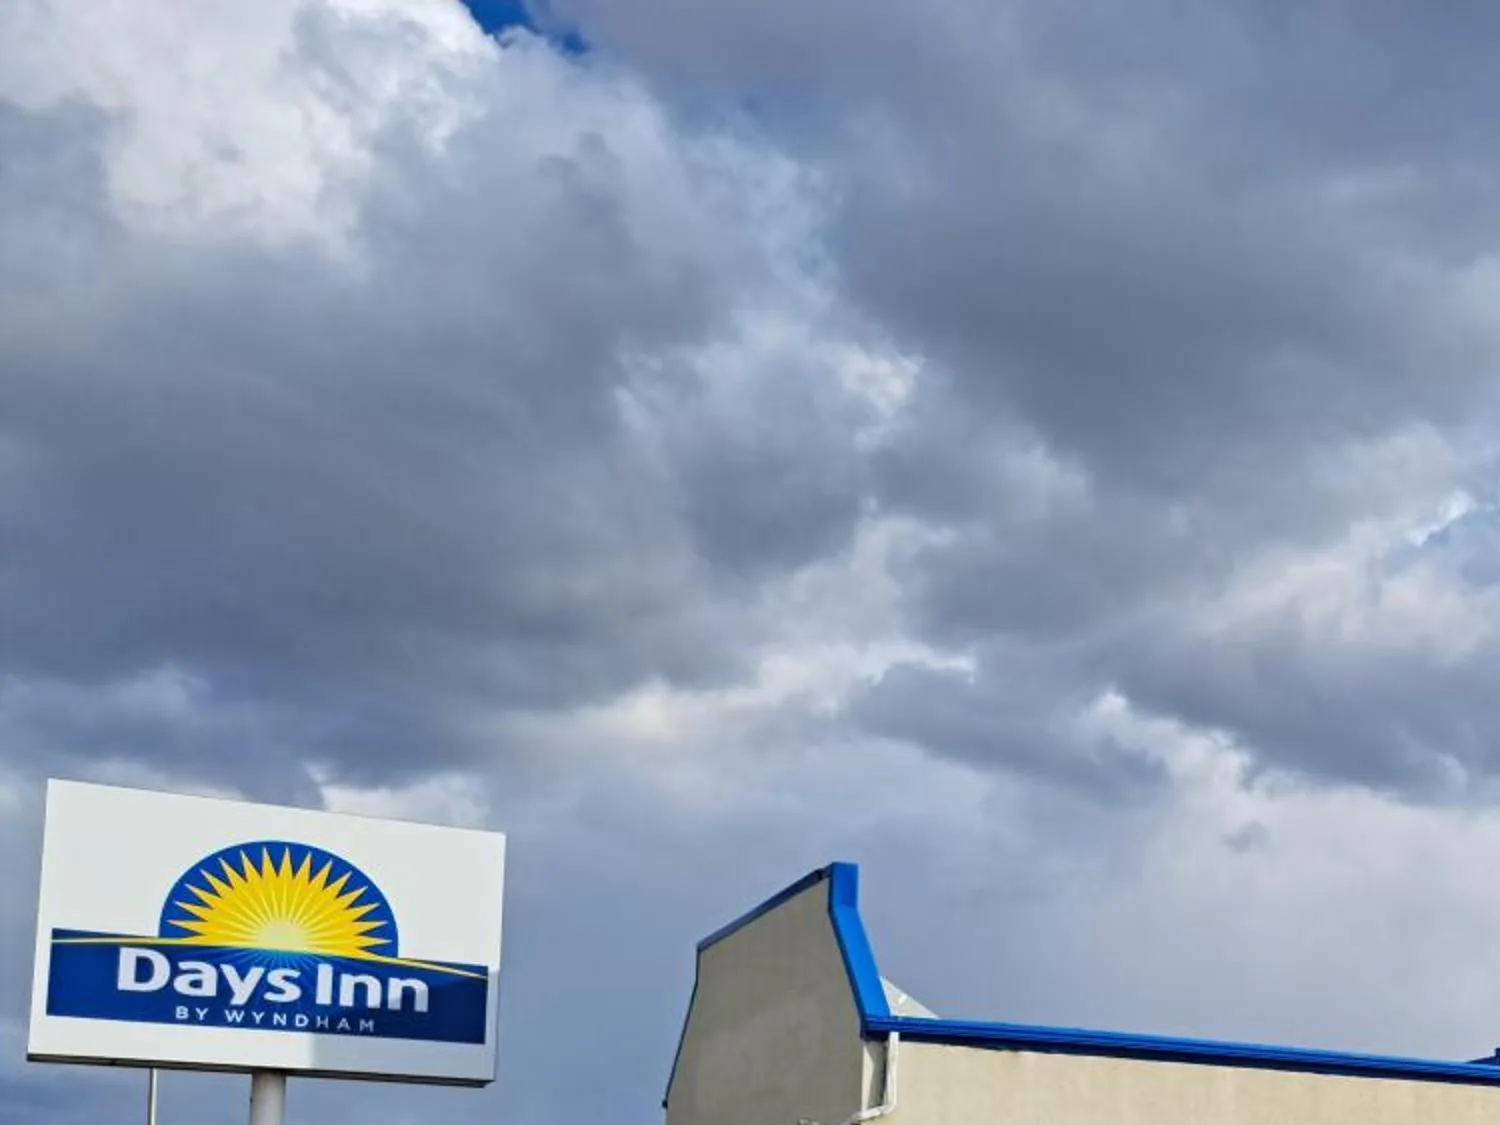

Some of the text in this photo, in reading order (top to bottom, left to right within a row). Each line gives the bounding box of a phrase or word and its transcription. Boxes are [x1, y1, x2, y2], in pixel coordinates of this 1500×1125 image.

[117, 946, 429, 1013] Days Inn
[175, 1005, 376, 1033] BY WYNDHAM
